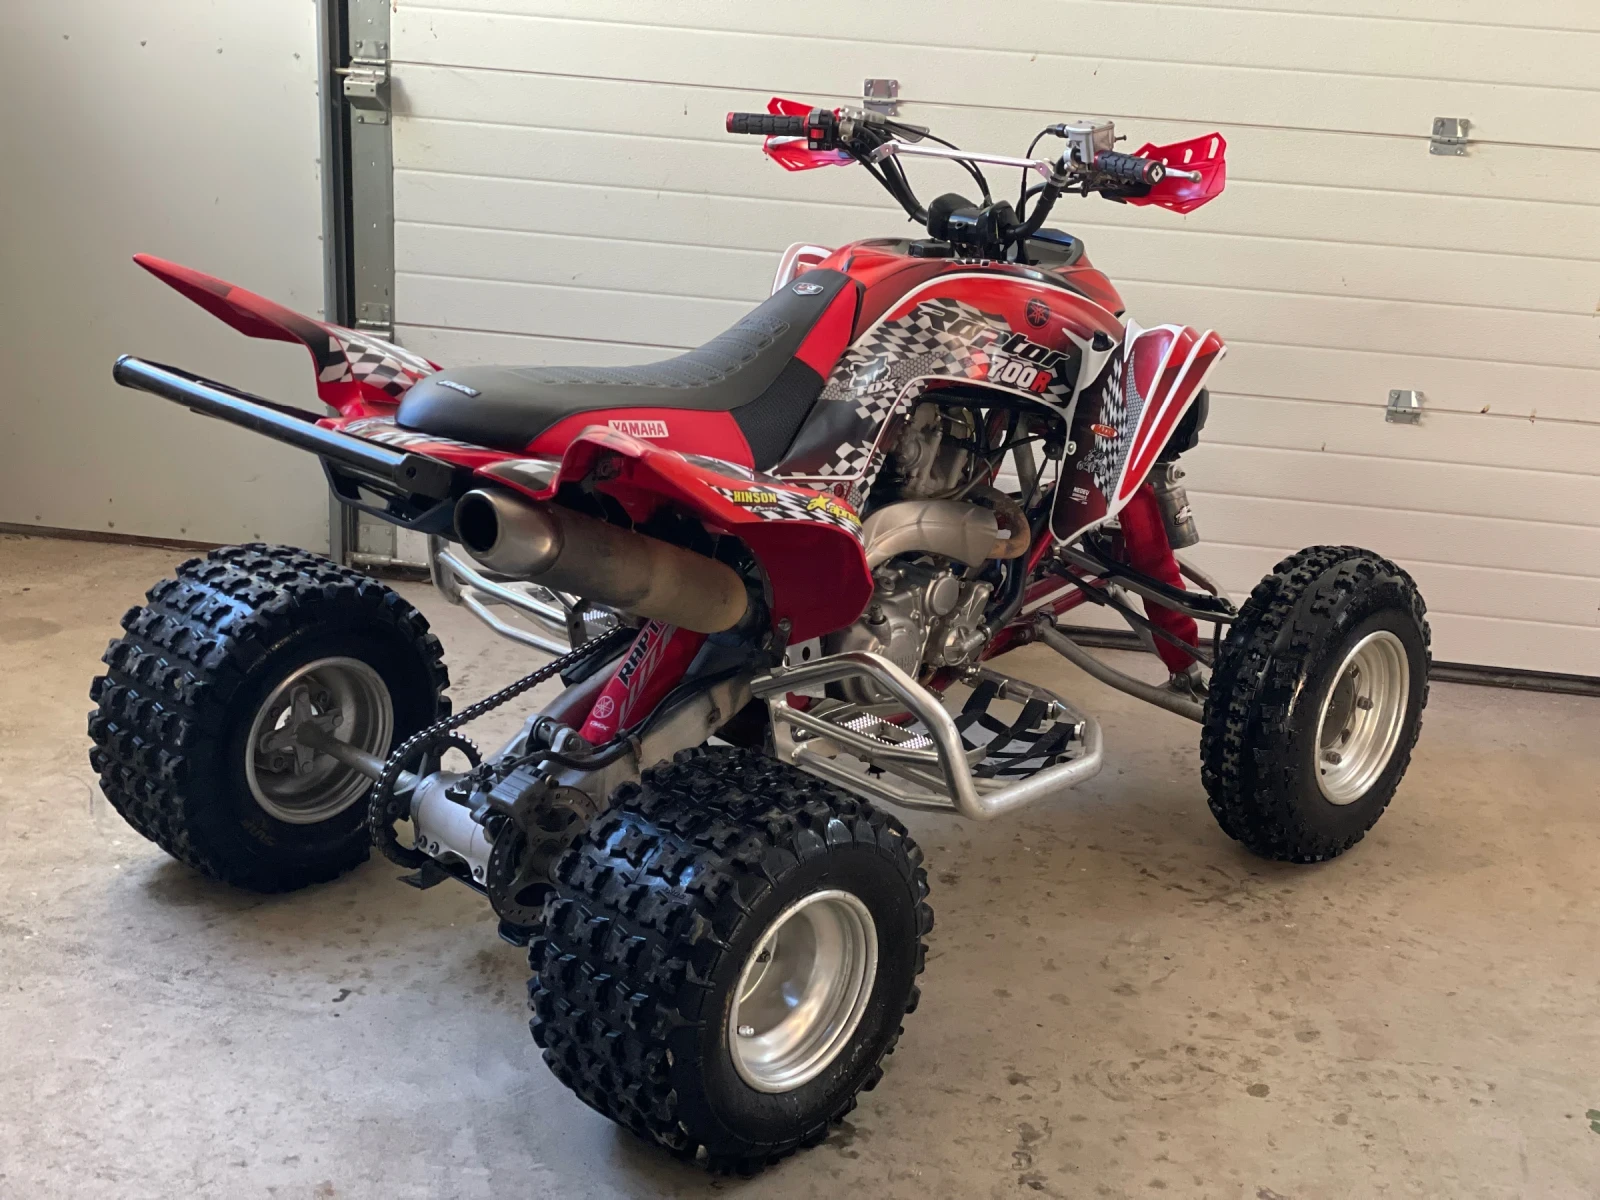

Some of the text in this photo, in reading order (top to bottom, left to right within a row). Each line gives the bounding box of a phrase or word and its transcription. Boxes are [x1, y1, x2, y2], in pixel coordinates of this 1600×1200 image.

[987, 354, 1053, 393] 700R
[856, 379, 897, 396] FOX
[612, 421, 666, 436] YAMAHA
[733, 490, 777, 504] HINSON
[617, 618, 666, 690] RAPT
